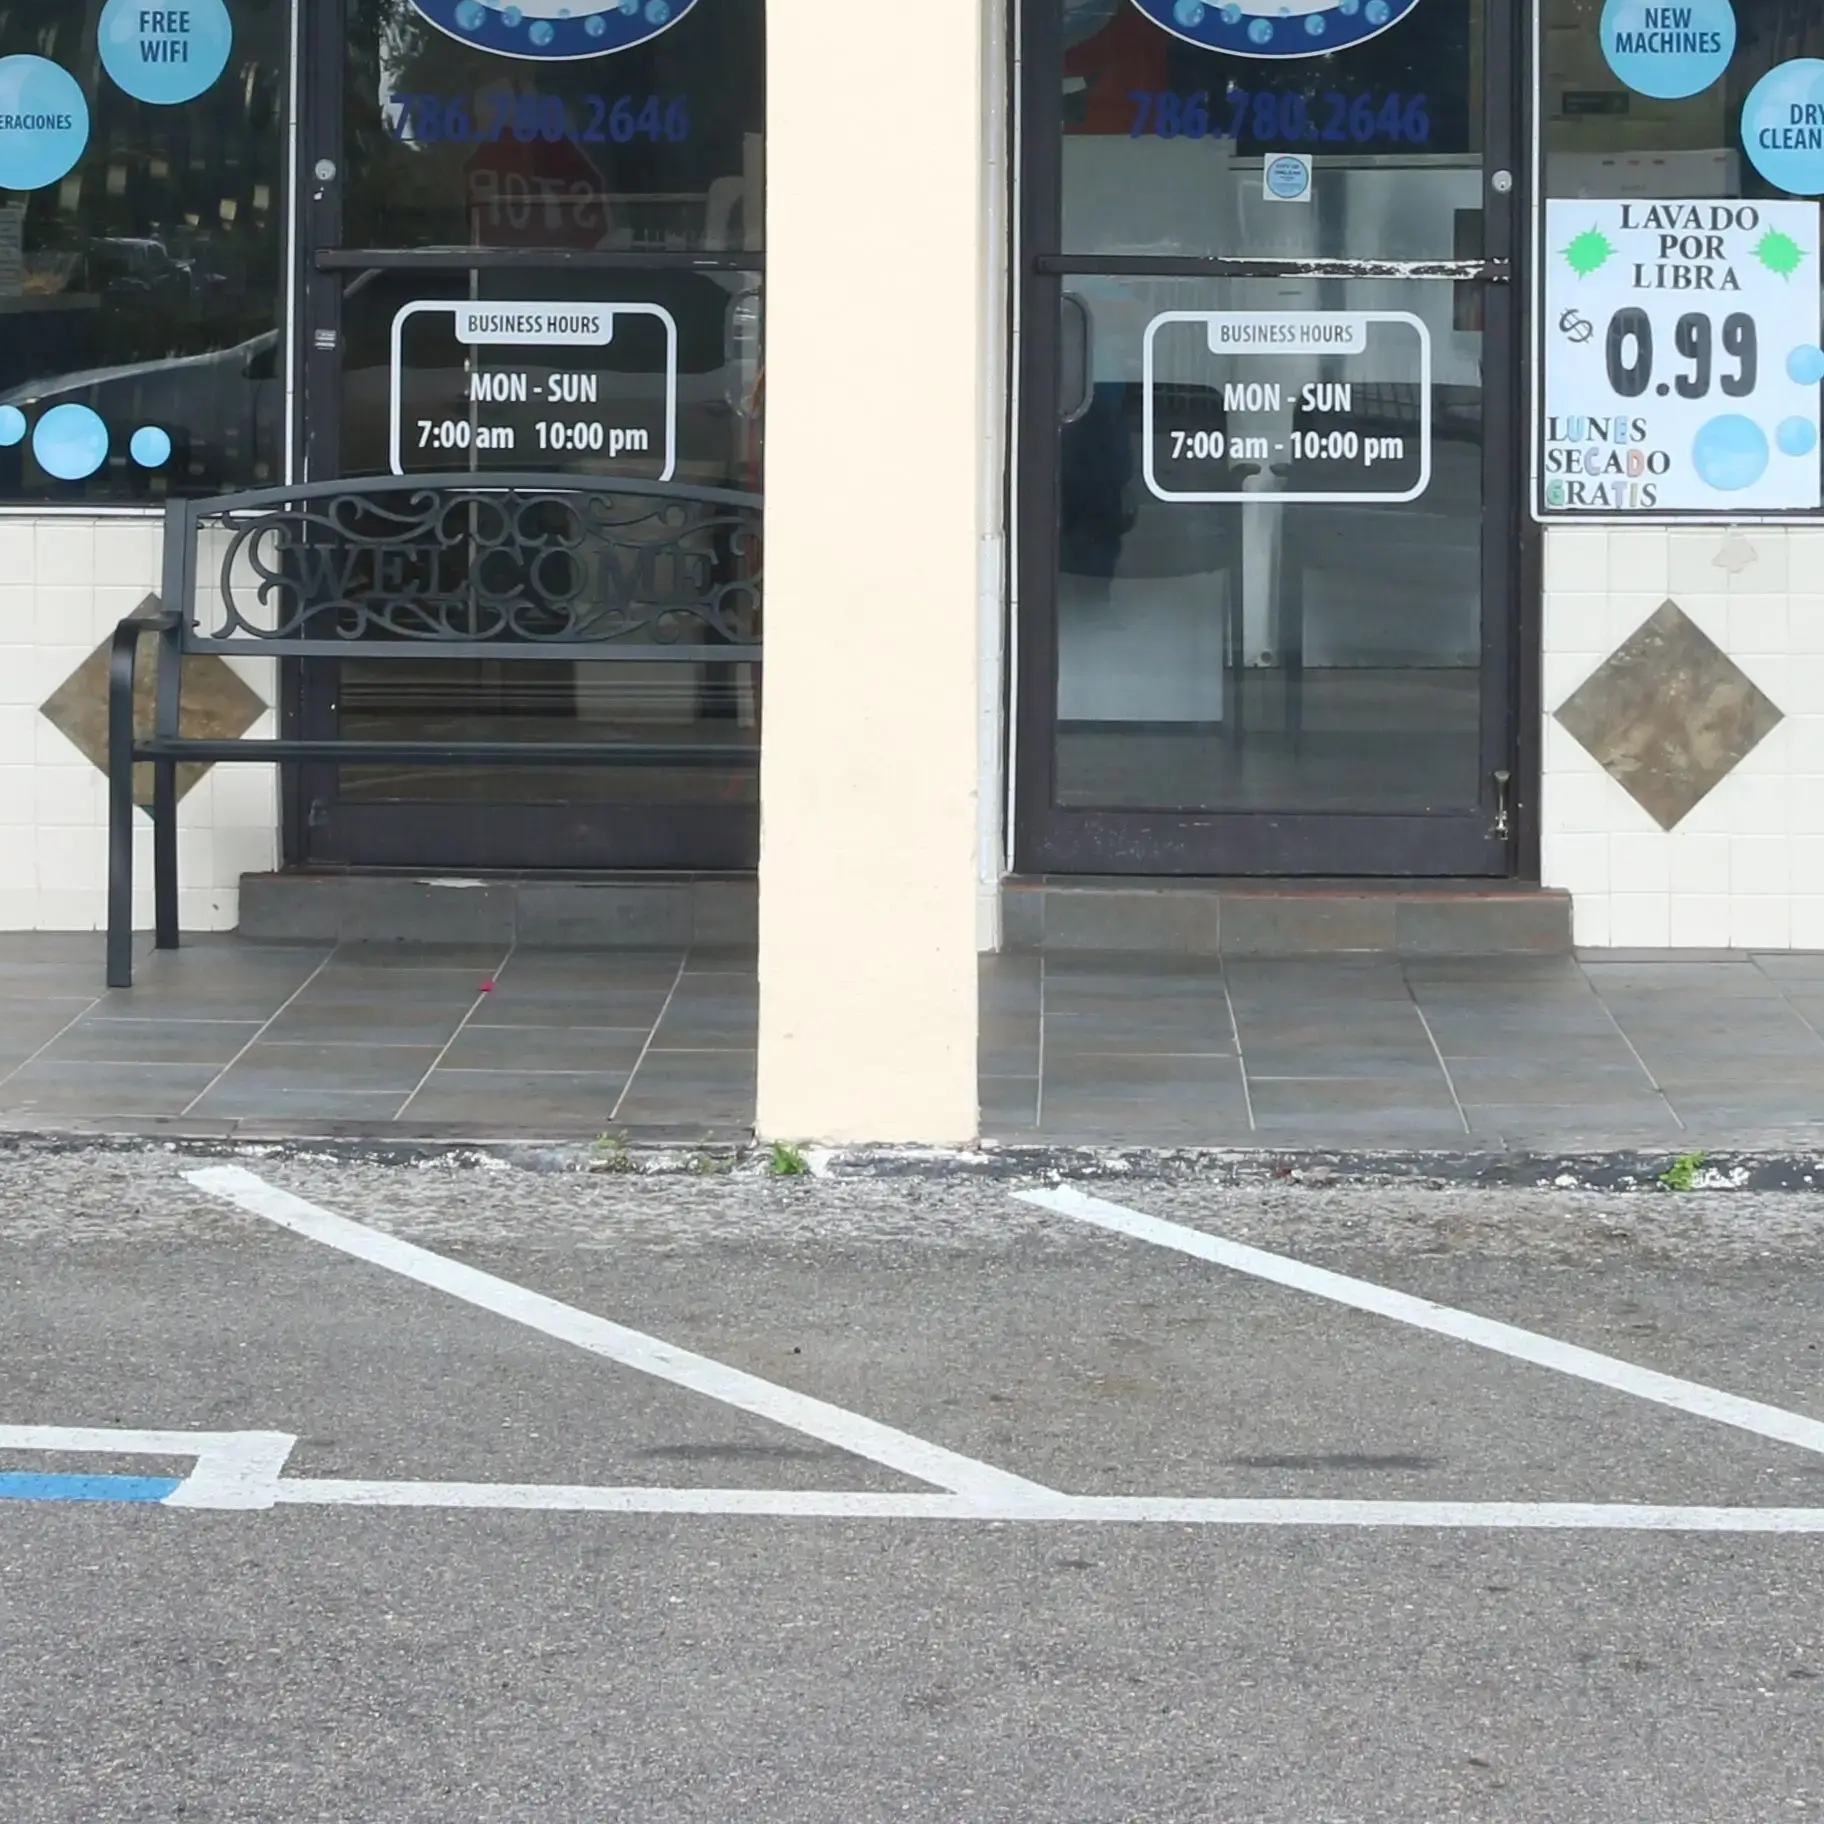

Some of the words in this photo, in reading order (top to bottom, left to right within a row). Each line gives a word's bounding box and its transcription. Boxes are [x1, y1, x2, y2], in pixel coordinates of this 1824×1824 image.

[139, 10, 190, 34] FREE
[1644, 7, 1692, 30] NEW
[139, 40, 189, 64] WIFI
[1614, 32, 1721, 54] MACHINES
[390, 93, 691, 143] 786.780.2646
[1126, 91, 1431, 143] 786.780.2646
[1619, 204, 1759, 231] LAVADO
[1658, 233, 1727, 260] POR
[1632, 263, 1741, 291] LIBRA
[467, 314, 543, 334] BUSINESS
[546, 315, 600, 334] HOURS
[1219, 324, 1296, 344] BUSINESS
[1300, 325, 1353, 344] HOURS
[470, 373, 527, 402] MON
[547, 374, 597, 402] SUN
[1223, 383, 1280, 412] MON
[1302, 383, 1352, 412] SUN
[417, 420, 470, 448] 7:00
[476, 427, 514, 449] am
[535, 422, 603, 450] 10:00
[609, 428, 648, 457] pm
[1547, 416, 1647, 444] LUNES
[1170, 430, 1225, 459] 7:00
[1230, 437, 1268, 459] am
[1291, 431, 1359, 460] 10:00
[1364, 437, 1403, 466] pm
[1546, 448, 1671, 477] SECADO
[1546, 479, 1658, 508] GRATIS
[284, 542, 719, 604] WELCOME
